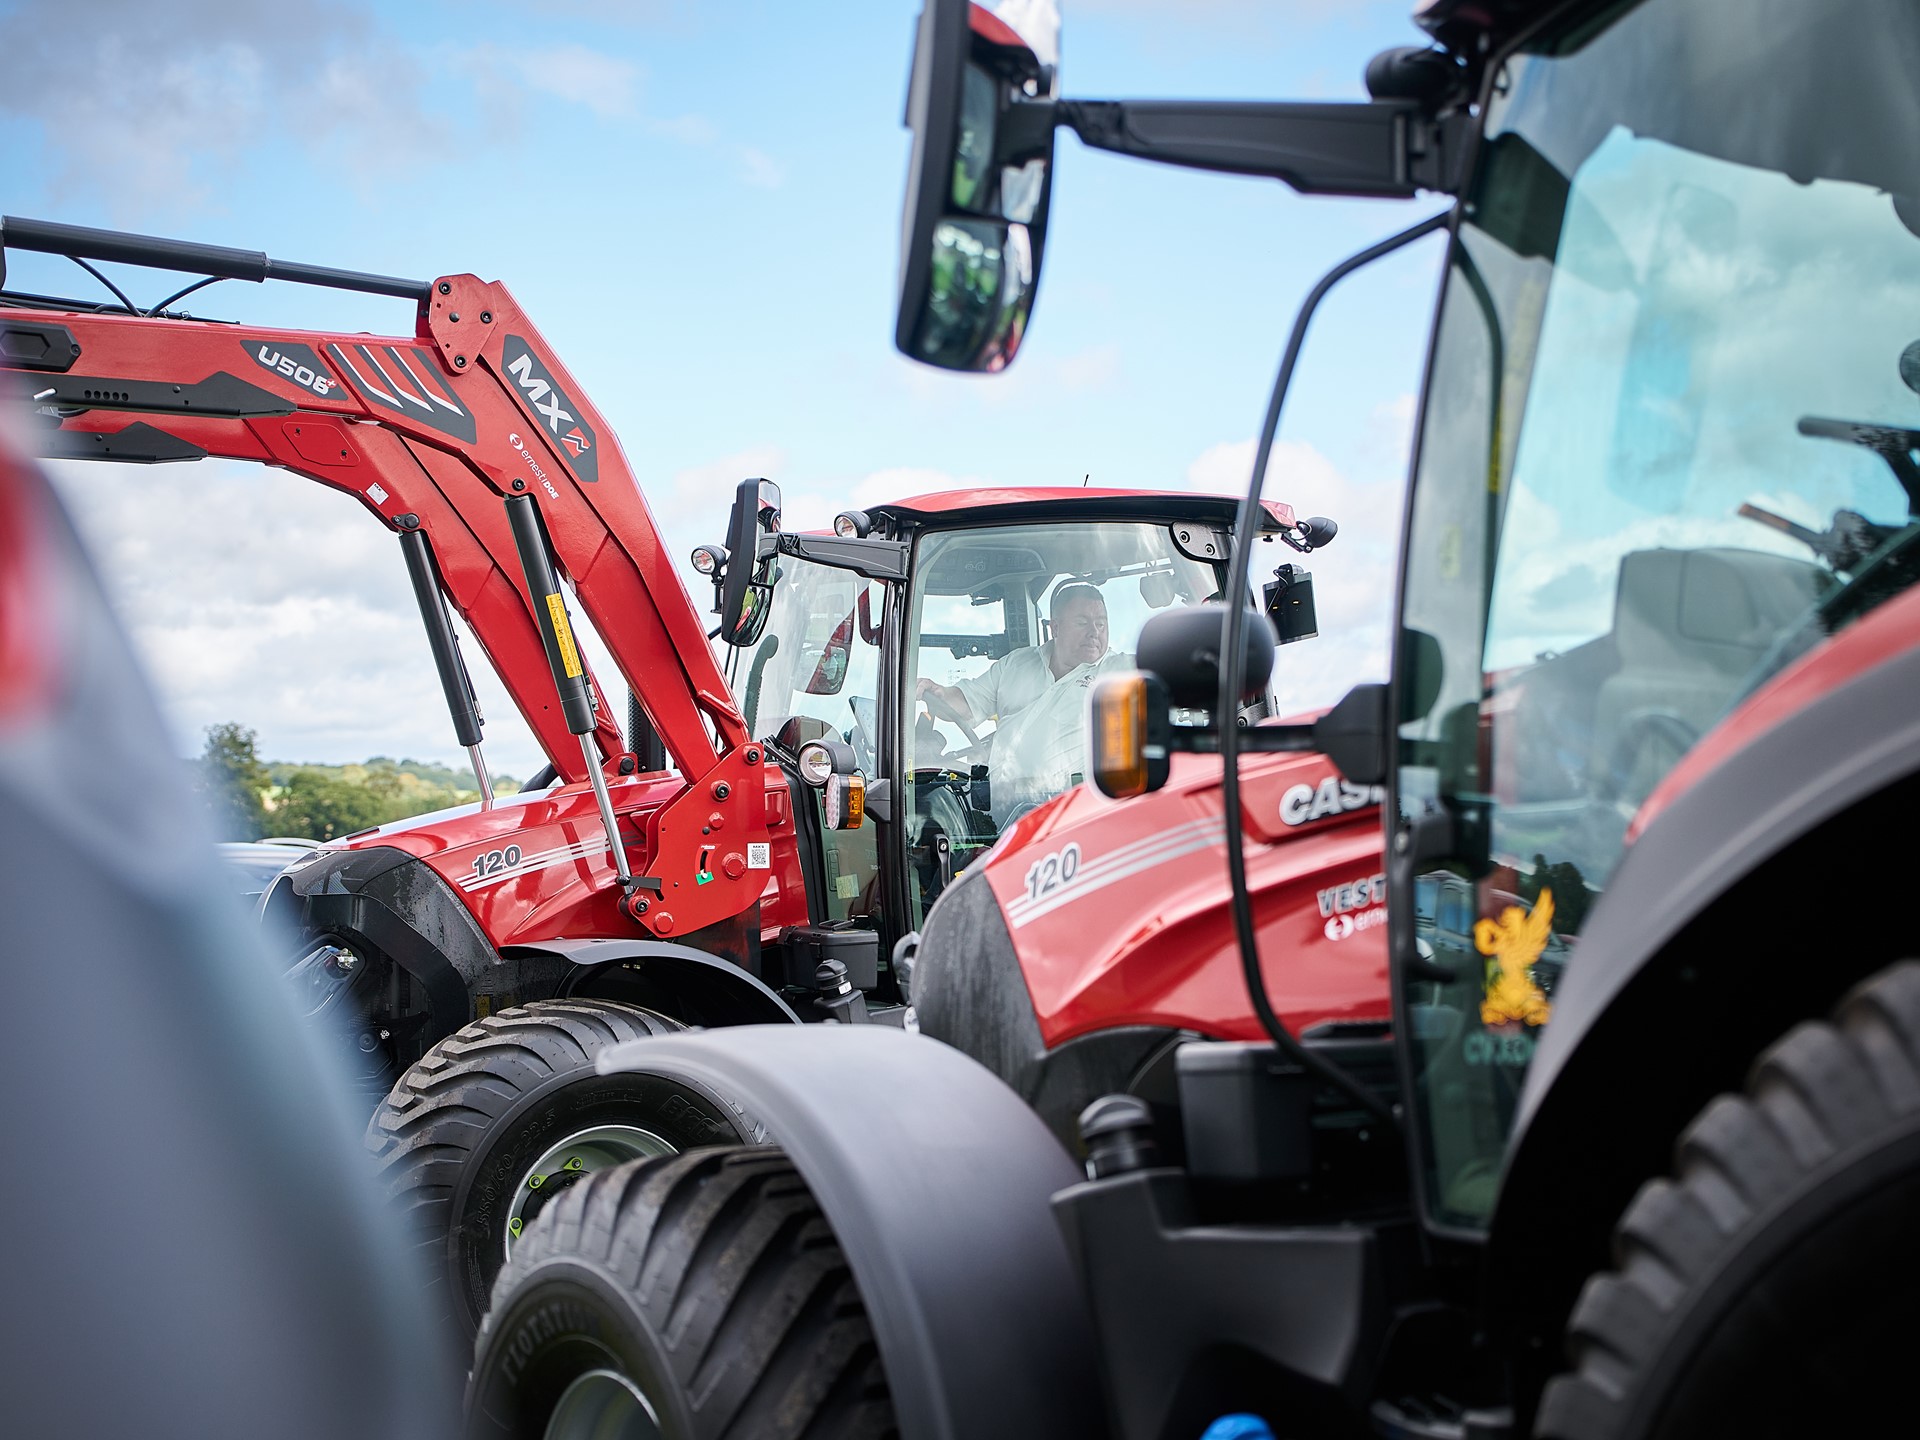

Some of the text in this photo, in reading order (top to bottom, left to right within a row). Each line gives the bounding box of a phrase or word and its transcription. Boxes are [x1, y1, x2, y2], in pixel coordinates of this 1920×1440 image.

[508, 353, 574, 434] MX
[472, 844, 522, 878] 120
[1024, 841, 1082, 902] 120
